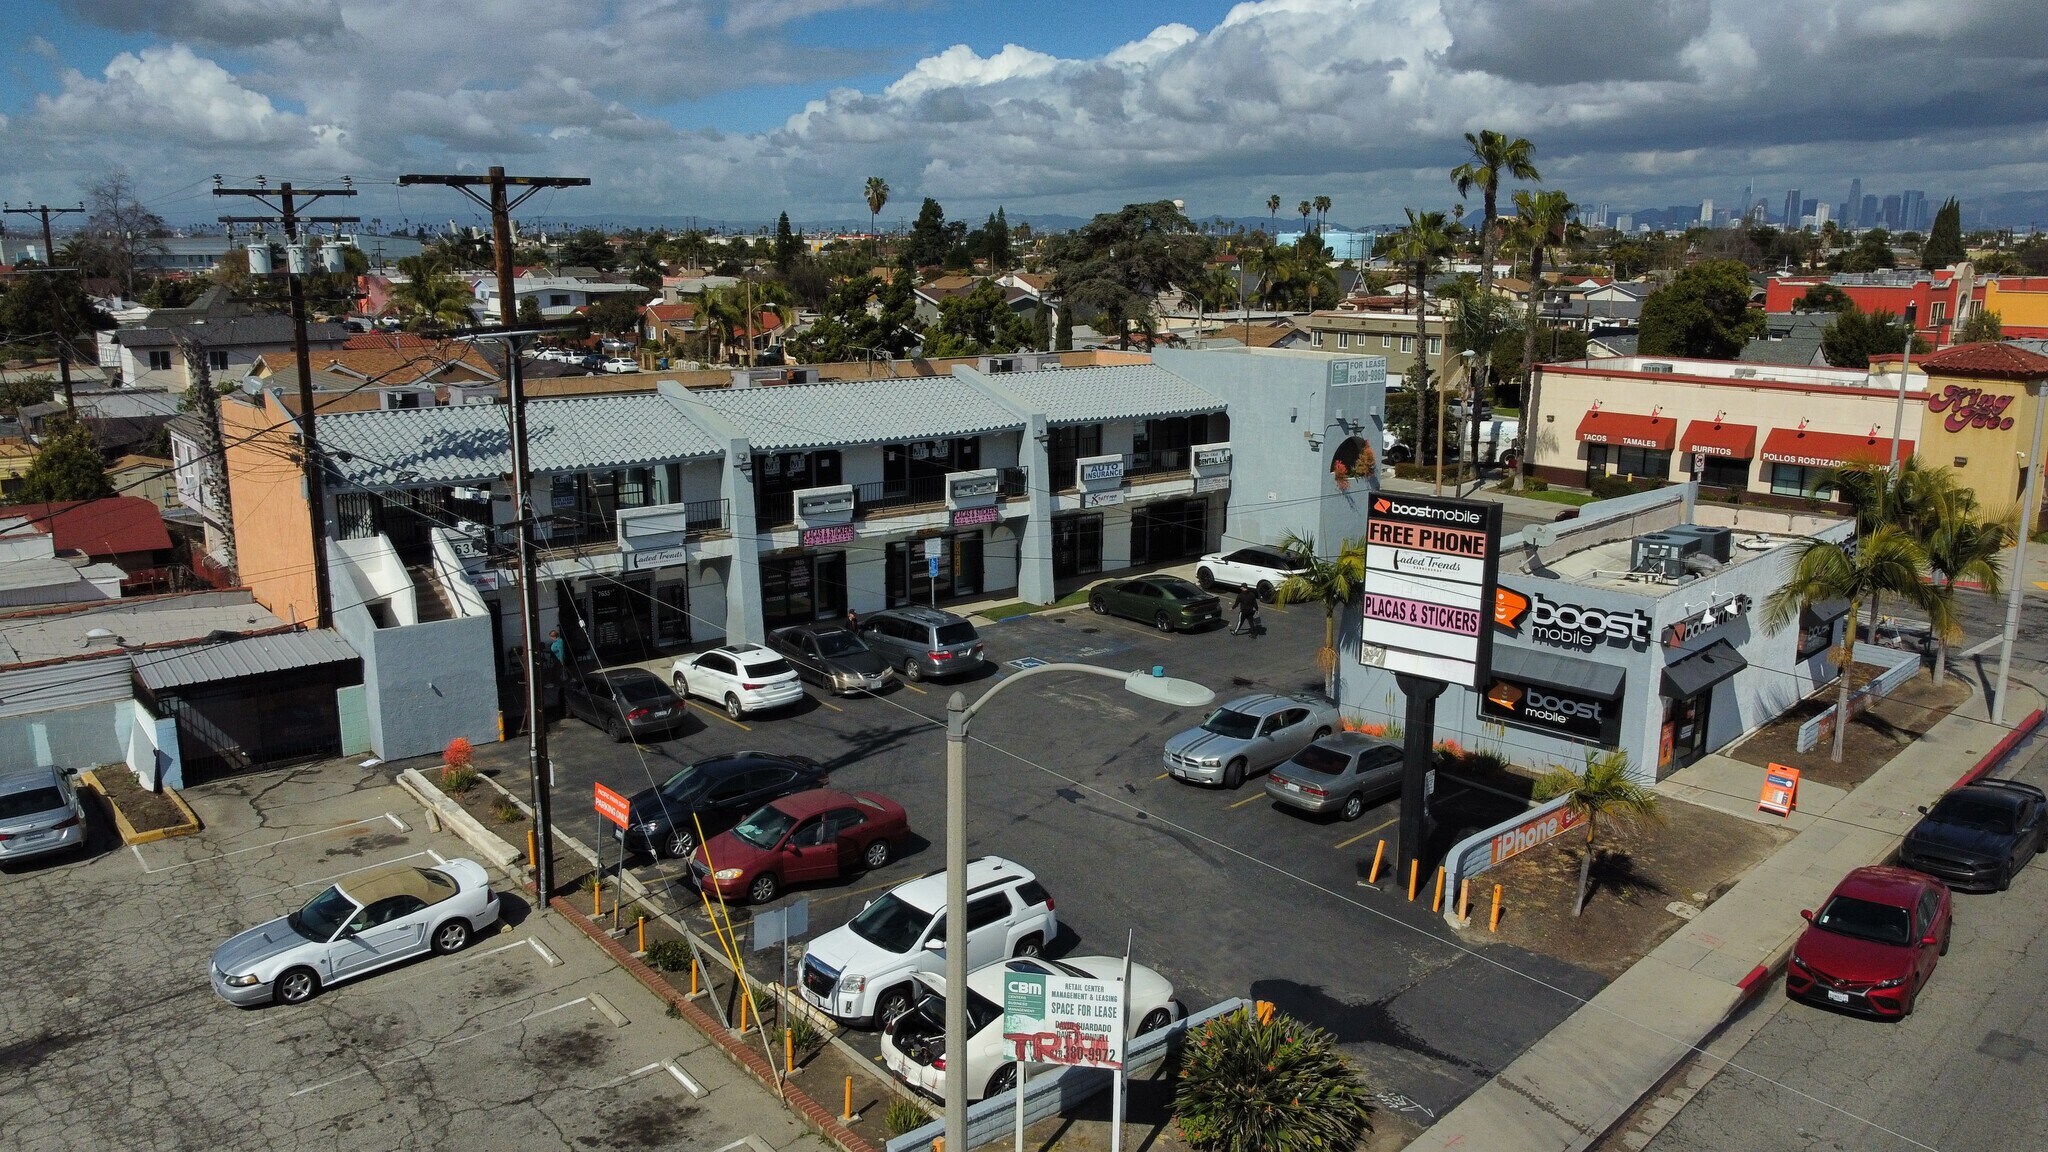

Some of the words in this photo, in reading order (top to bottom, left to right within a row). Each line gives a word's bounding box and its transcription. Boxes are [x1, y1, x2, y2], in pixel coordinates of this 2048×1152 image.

[1350, 361, 1363, 369] FOR
[1366, 360, 1385, 368] LEASE
[1929, 385, 2015, 415] King
[1944, 405, 2015, 433] Taco
[1583, 433, 1607, 442] TACOS
[1623, 437, 1656, 447] TAMALES
[1691, 444, 1732, 455] BURRITOS
[1763, 452, 1796, 463] POLLOS
[1086, 469, 1122, 480] INSURANCE
[1091, 463, 1118, 472] AUTO
[1391, 502, 1480, 524] boostmobile
[1370, 523, 1414, 545] FREE
[1419, 529, 1485, 555] PHONE
[657, 551, 682, 560] Trends
[1426, 556, 1461, 571] Trends
[1365, 596, 1406, 621] PLACAS
[1409, 603, 1417, 622] &
[1421, 605, 1478, 633] STICKERS
[1531, 596, 1647, 642] boost
[1531, 625, 1593, 646] mobile
[1527, 688, 1602, 721] boost
[1525, 707, 1567, 723] mobile
[595, 797, 616, 816] PARKING
[616, 810, 628, 824] ONLY
[1497, 816, 1558, 860] iPhone
[1065, 983, 1082, 991] RETAIL
[1085, 984, 1104, 992] CENTER
[1051, 991, 1087, 1000] MANAGEMENT
[1095, 994, 1117, 1002] LEASING
[1051, 1002, 1074, 1015] SPACE
[1078, 1004, 1091, 1017] FOR
[1094, 1005, 1117, 1018] LEASE
